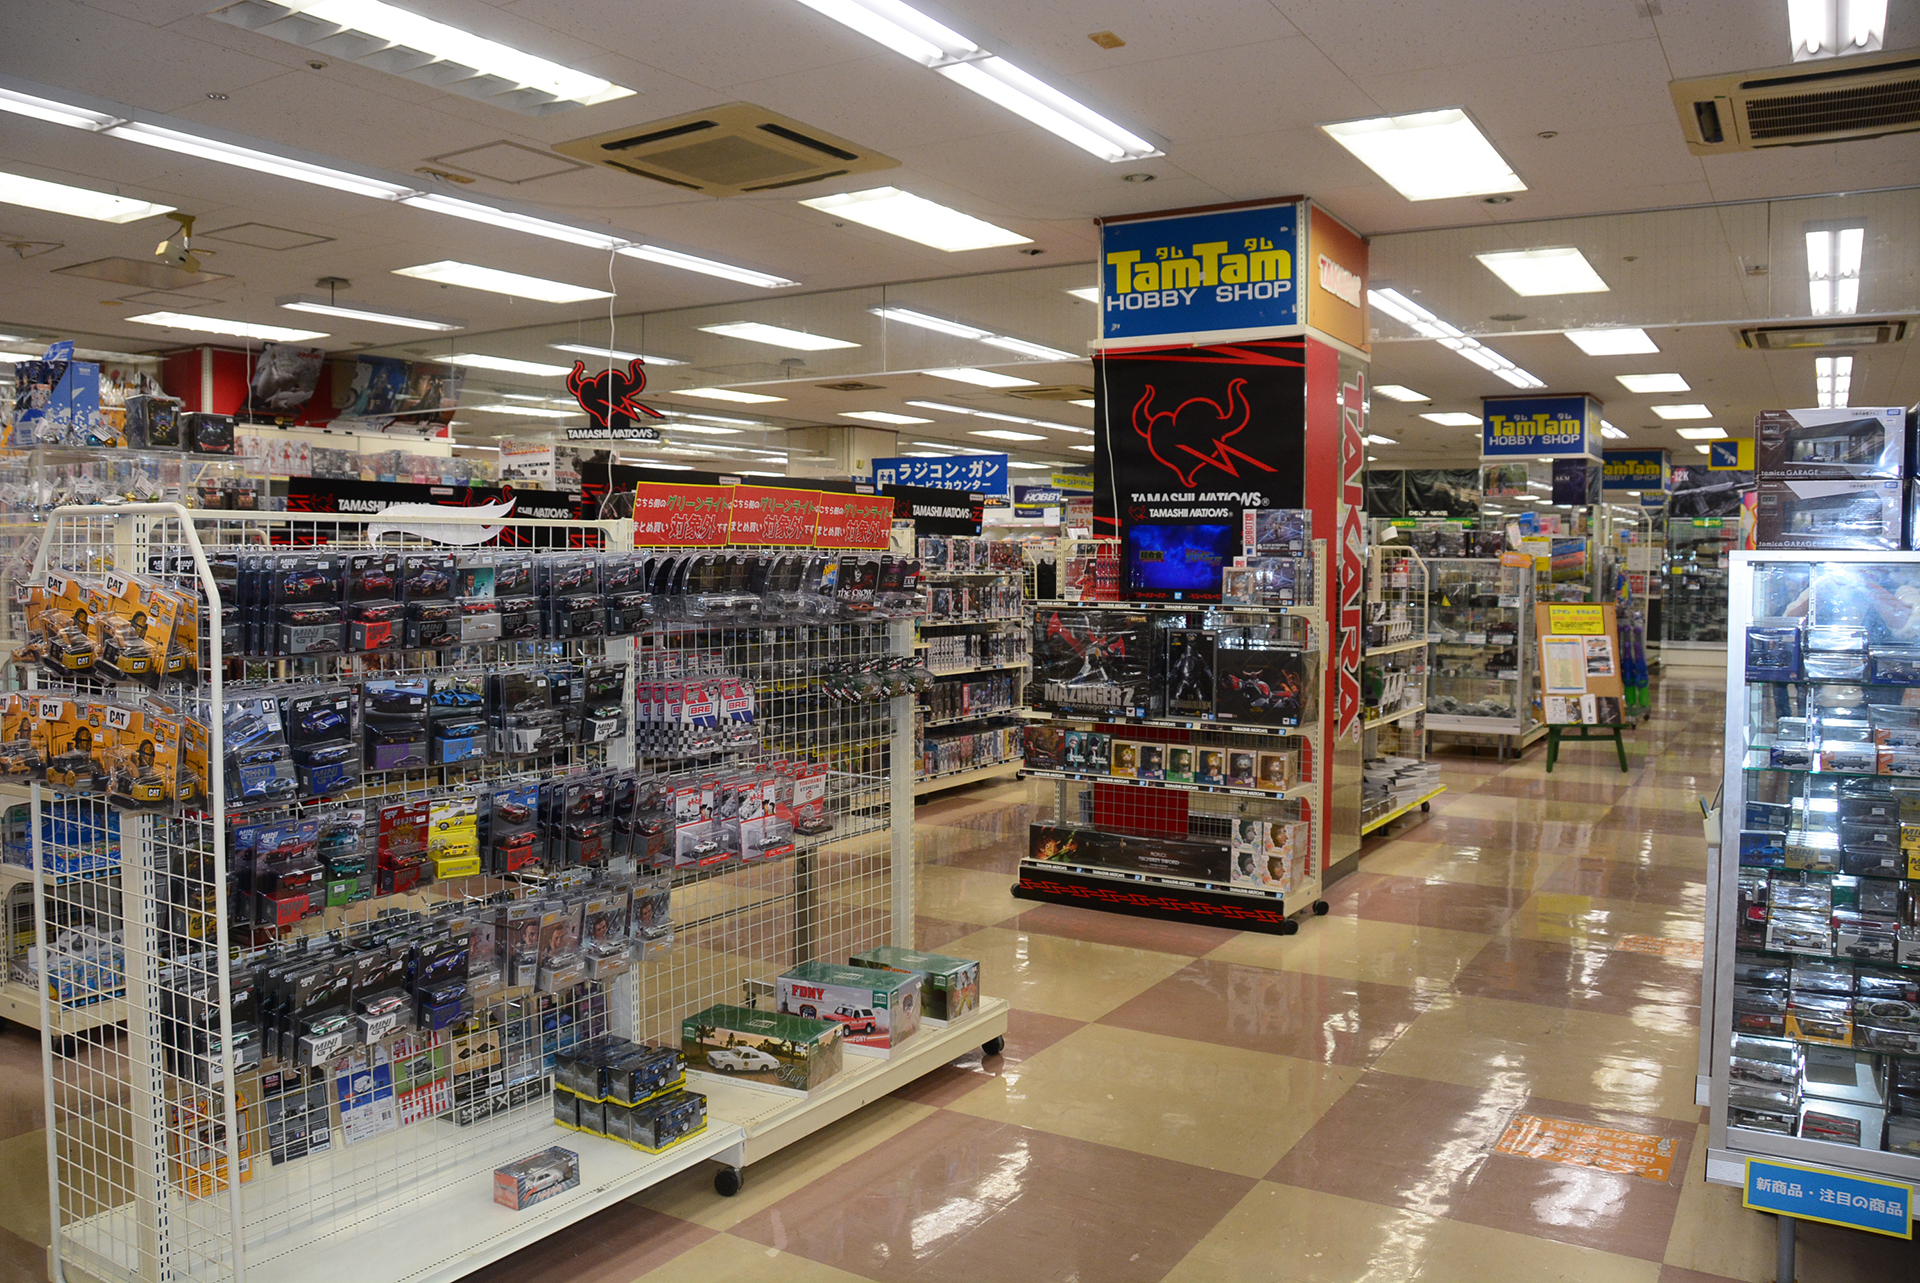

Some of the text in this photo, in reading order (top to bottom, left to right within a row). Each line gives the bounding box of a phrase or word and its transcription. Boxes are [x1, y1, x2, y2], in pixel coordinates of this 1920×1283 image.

[1244, 236, 1274, 251] タム
[1156, 246, 1183, 260] タム
[1107, 240, 1291, 293] TamTam
[1107, 280, 1292, 312] HOBBY SHOP
[1489, 414, 1580, 437] TamTam
[568, 429, 653, 439] TAMASHII NATIONS
[1489, 433, 1580, 446] HOBBY SHOP
[899, 460, 1000, 480] ラジコン・ガン
[1603, 460, 1661, 475] amTam
[1131, 492, 1262, 507] TAMASHII NATIONS
[534, 507, 570, 519] NATIONS
[912, 505, 970, 519] TAMASHII NATIONS
[1149, 508, 1229, 518] TAMASHII NATIONS
[731, 514, 815, 540] まとめ買い対象外です
[816, 519, 890, 544] まとめ買い対象外です
[47, 576, 63, 593] CAT
[106, 576, 124, 594] CAT
[503, 615, 524, 623] MINI
[572, 613, 593, 621] MINI
[623, 610, 639, 618] MINI
[293, 628, 319, 637] MINI
[367, 624, 388, 633] MINI
[420, 623, 443, 631] MINI
[368, 632, 386, 640] GT
[423, 630, 438, 638] GT
[295, 636, 314, 644] GT
[77, 655, 89, 666] CAT
[133, 660, 146, 670] CAT
[168, 659, 181, 668] CAT
[1044, 683, 1135, 707] MAZINGER Z
[261, 700, 276, 711] D1
[296, 701, 313, 709] MINI
[690, 704, 711, 715] BRE
[728, 699, 748, 709] BRE
[42, 703, 58, 717] CAT
[109, 709, 126, 725] CAT
[596, 722, 615, 731] MINI
[444, 740, 468, 748] MINI
[313, 766, 339, 776] MINI
[316, 774, 335, 785] GT
[148, 788, 160, 797] CAT
[260, 830, 280, 839] MINI
[509, 849, 529, 858] MINI
[279, 898, 305, 909] MINI
[422, 944, 438, 954] MINI
[358, 957, 374, 967] MINI
[300, 974, 317, 984] MINI
[791, 984, 825, 1001] FDNY
[369, 1018, 393, 1031] MINI
[371, 1027, 388, 1036] GT
[315, 1037, 338, 1050] MINI
[853, 1035, 867, 1044] FDNY
[316, 1047, 334, 1057] GT
[774, 1065, 807, 1088] Fury
[1755, 1175, 1903, 1217] 新商品・注目の商品
